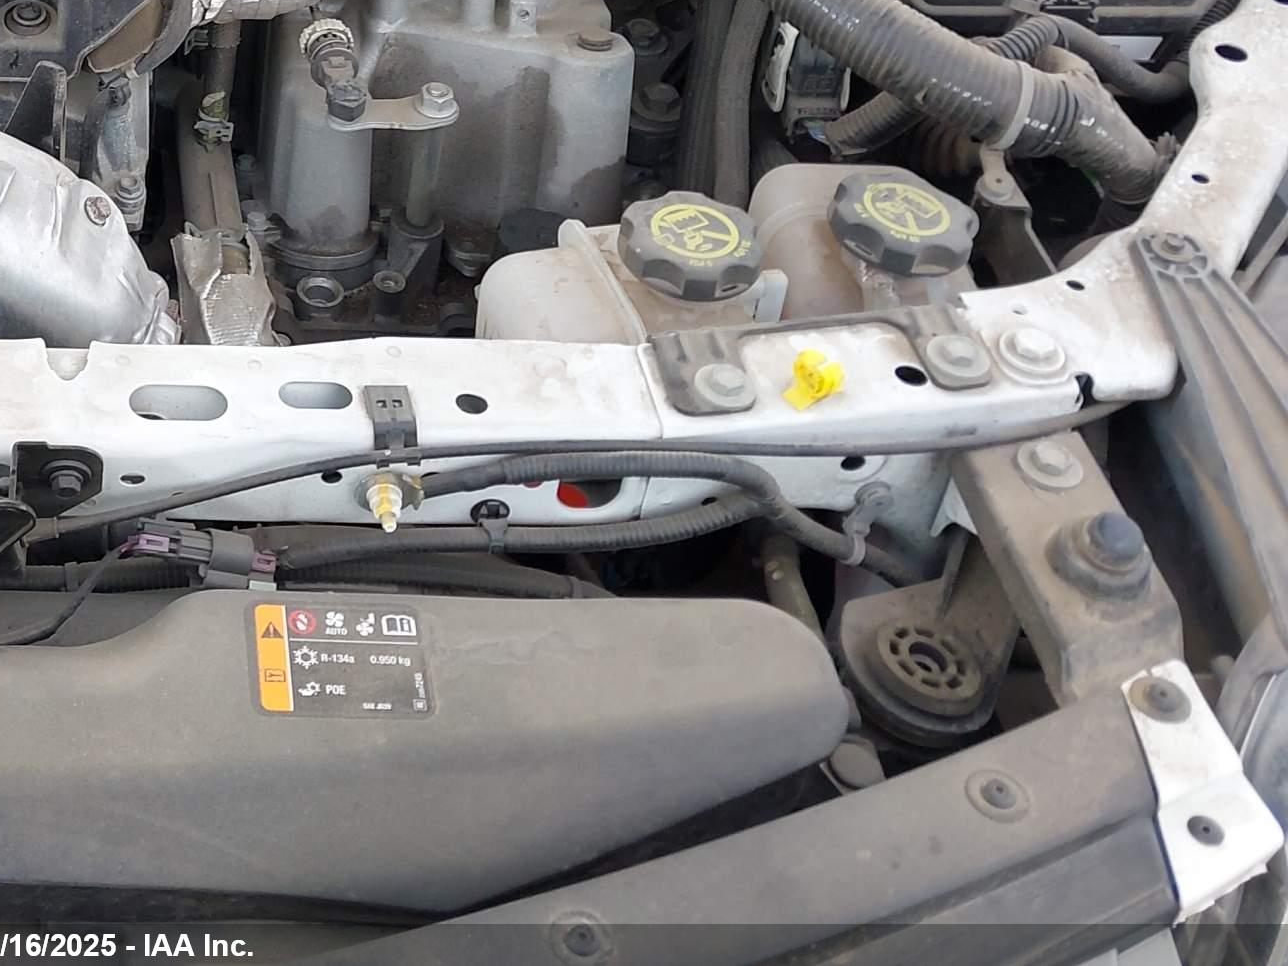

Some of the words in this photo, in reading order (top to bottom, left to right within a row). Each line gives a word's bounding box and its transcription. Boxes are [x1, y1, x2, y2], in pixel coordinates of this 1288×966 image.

[325, 627, 348, 636] AUTO
[320, 653, 355, 664] R-134a
[398, 656, 411, 667] kg
[325, 683, 347, 696] POE
